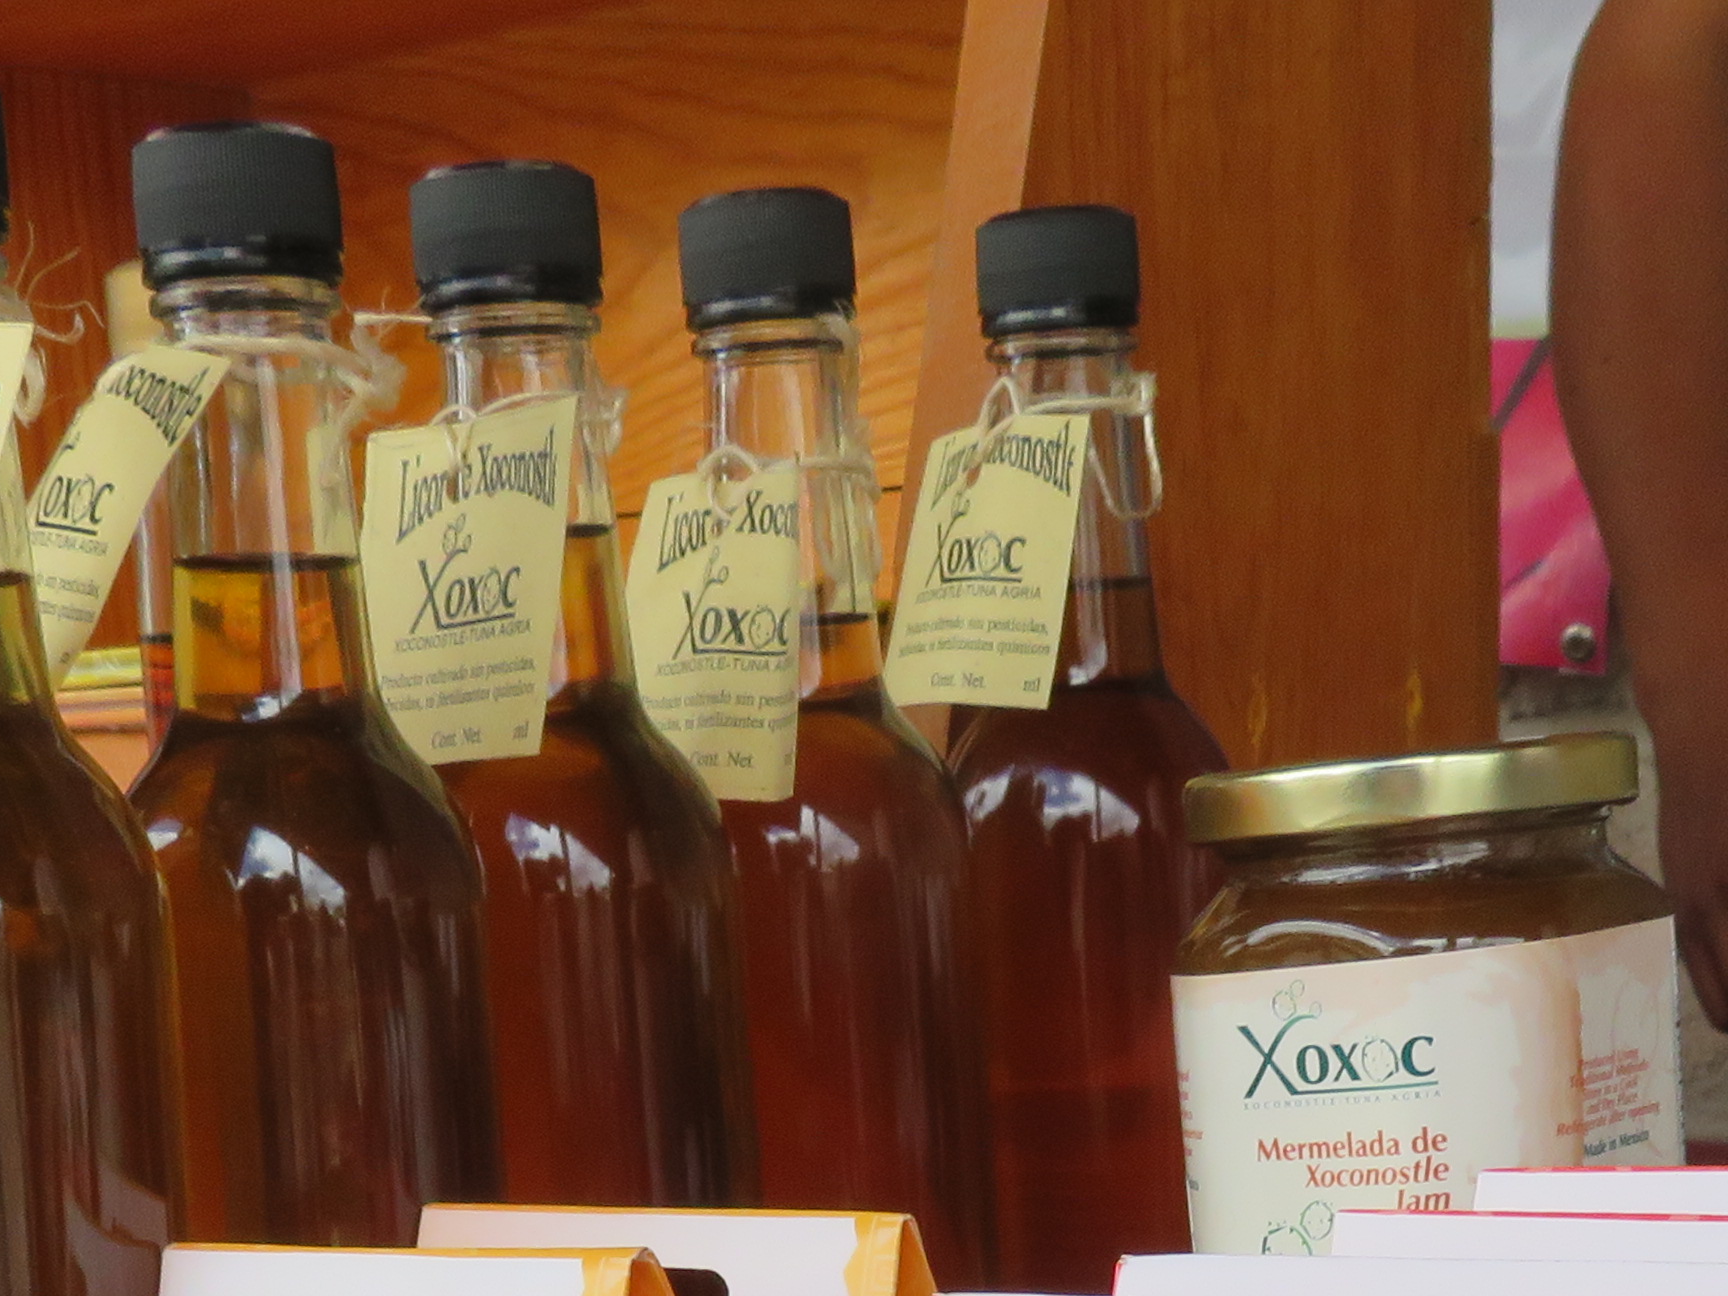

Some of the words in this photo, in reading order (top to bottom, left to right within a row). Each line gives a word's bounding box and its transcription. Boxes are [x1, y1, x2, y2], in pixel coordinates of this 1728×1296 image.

[396, 454, 447, 544] Licor
[657, 491, 712, 574] Licor
[925, 511, 1027, 588] Xoxoc
[410, 549, 520, 635] Xoxoc
[1000, 586, 1041, 600] AGRIA
[1237, 1013, 1441, 1100] Xoxoc
[1391, 1088, 1443, 1101] AGRIA
[1257, 1130, 1401, 1163] Mermelada
[1411, 1126, 1449, 1154] de
[1305, 1155, 1451, 1189] Xoconostle
[1396, 1189, 1452, 1211] Jam
